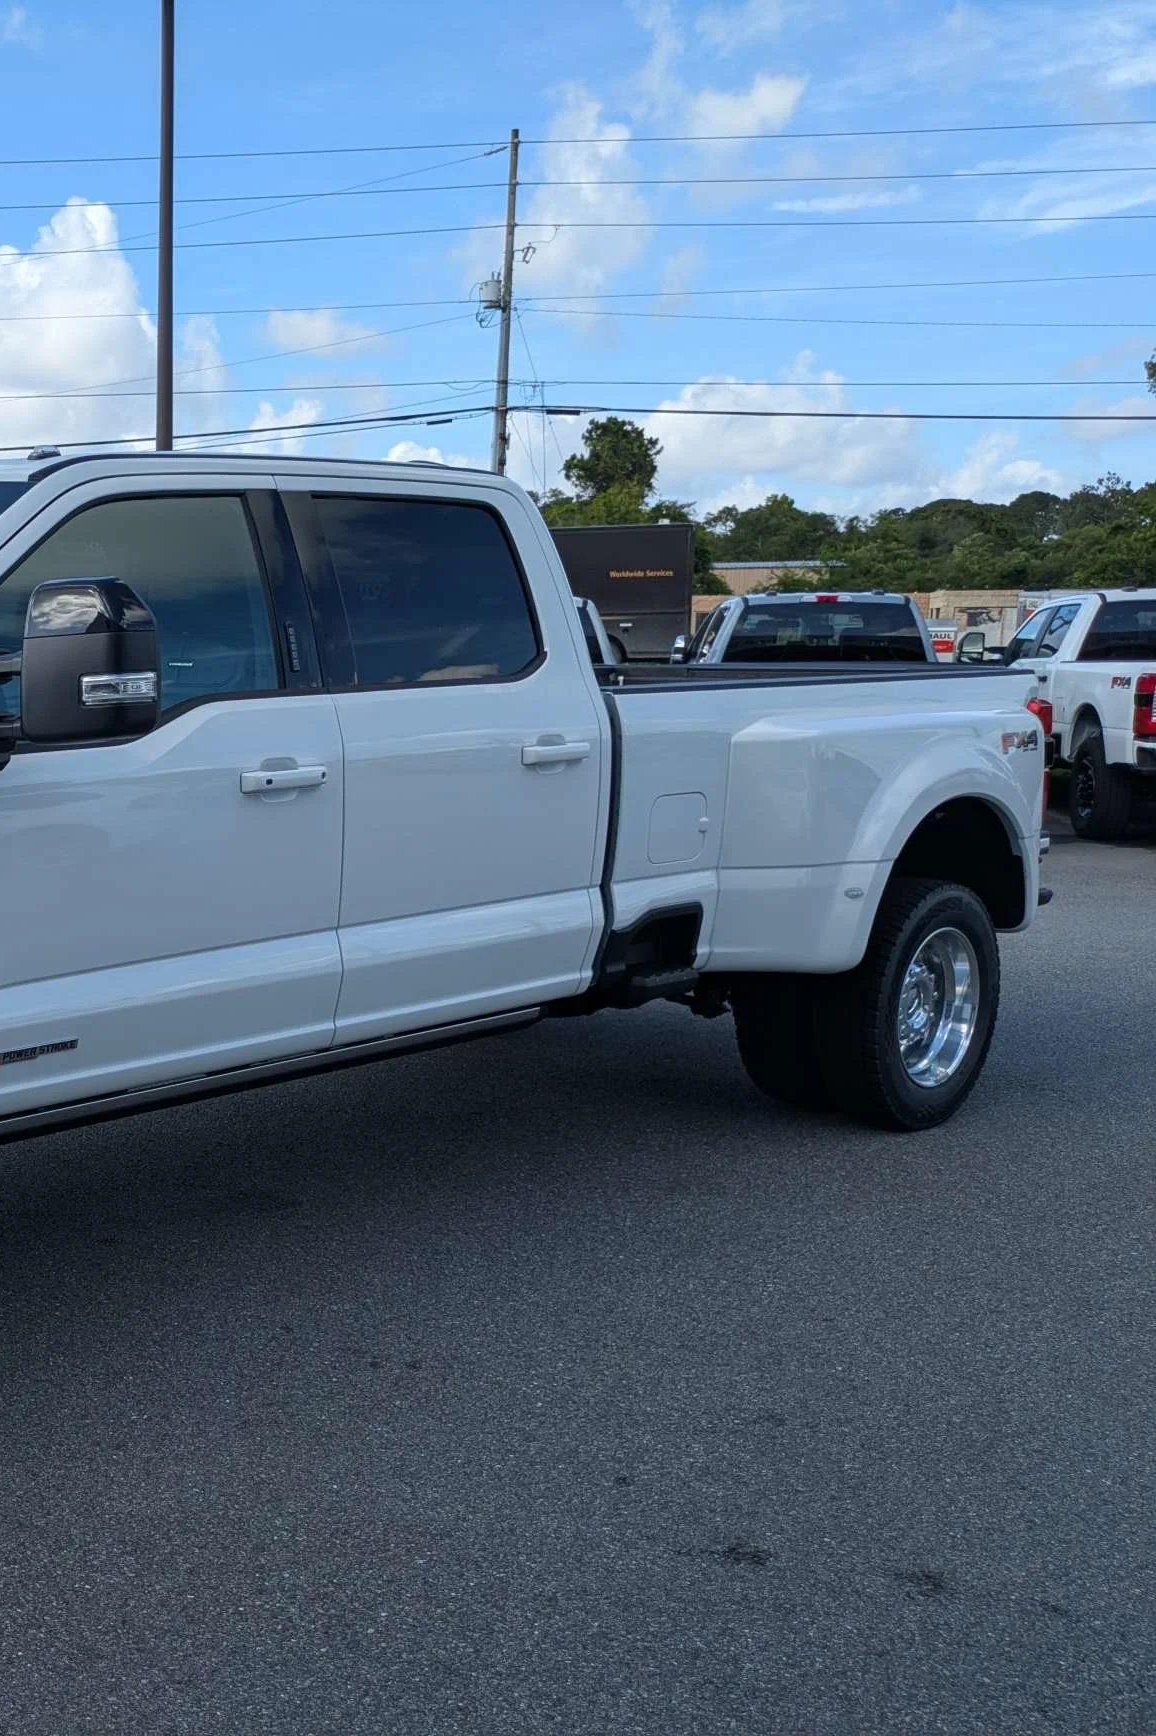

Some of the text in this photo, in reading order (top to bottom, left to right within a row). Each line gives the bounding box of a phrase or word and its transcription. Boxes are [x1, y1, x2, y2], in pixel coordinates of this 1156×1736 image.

[610, 569, 673, 578] Worldwide Services
[1111, 677, 1131, 689] FX4
[1001, 730, 1038, 754] FX4
[2, 1047, 36, 1061] POWER
[38, 1040, 77, 1055] STROKE
